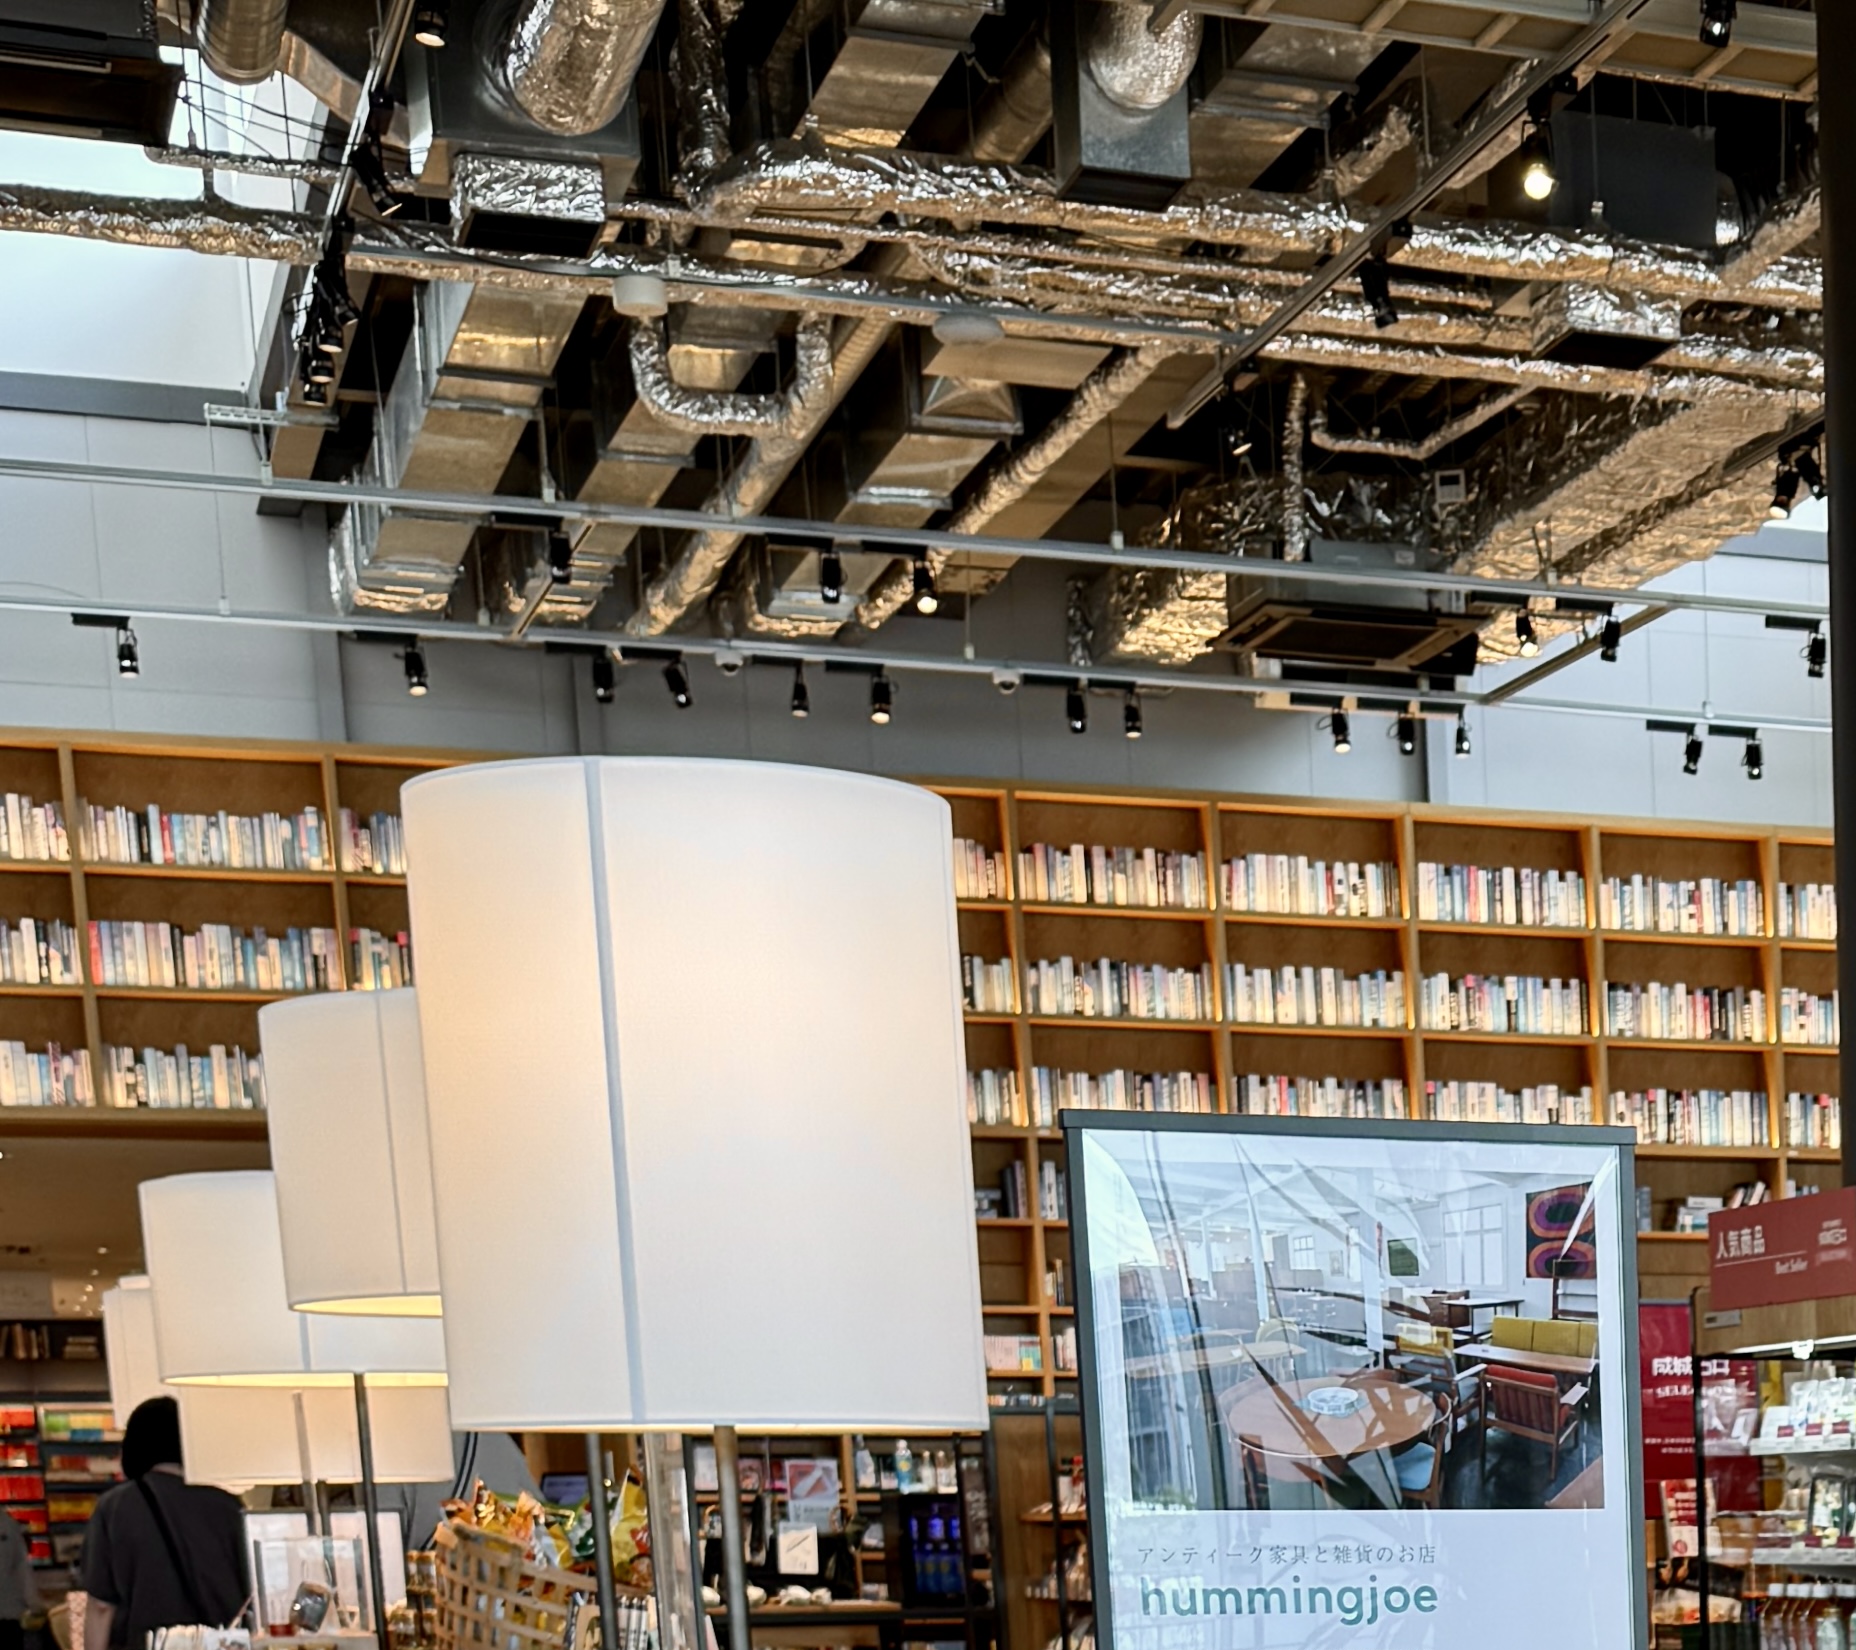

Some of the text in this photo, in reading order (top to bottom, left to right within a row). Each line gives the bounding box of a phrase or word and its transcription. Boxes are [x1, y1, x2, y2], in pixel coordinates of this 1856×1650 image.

[1716, 1225, 1765, 1259] 人気商品
[1138, 1544, 1436, 1565] アンティーク家具と雑貨のお店
[1140, 1574, 1438, 1626] hummingjoe
